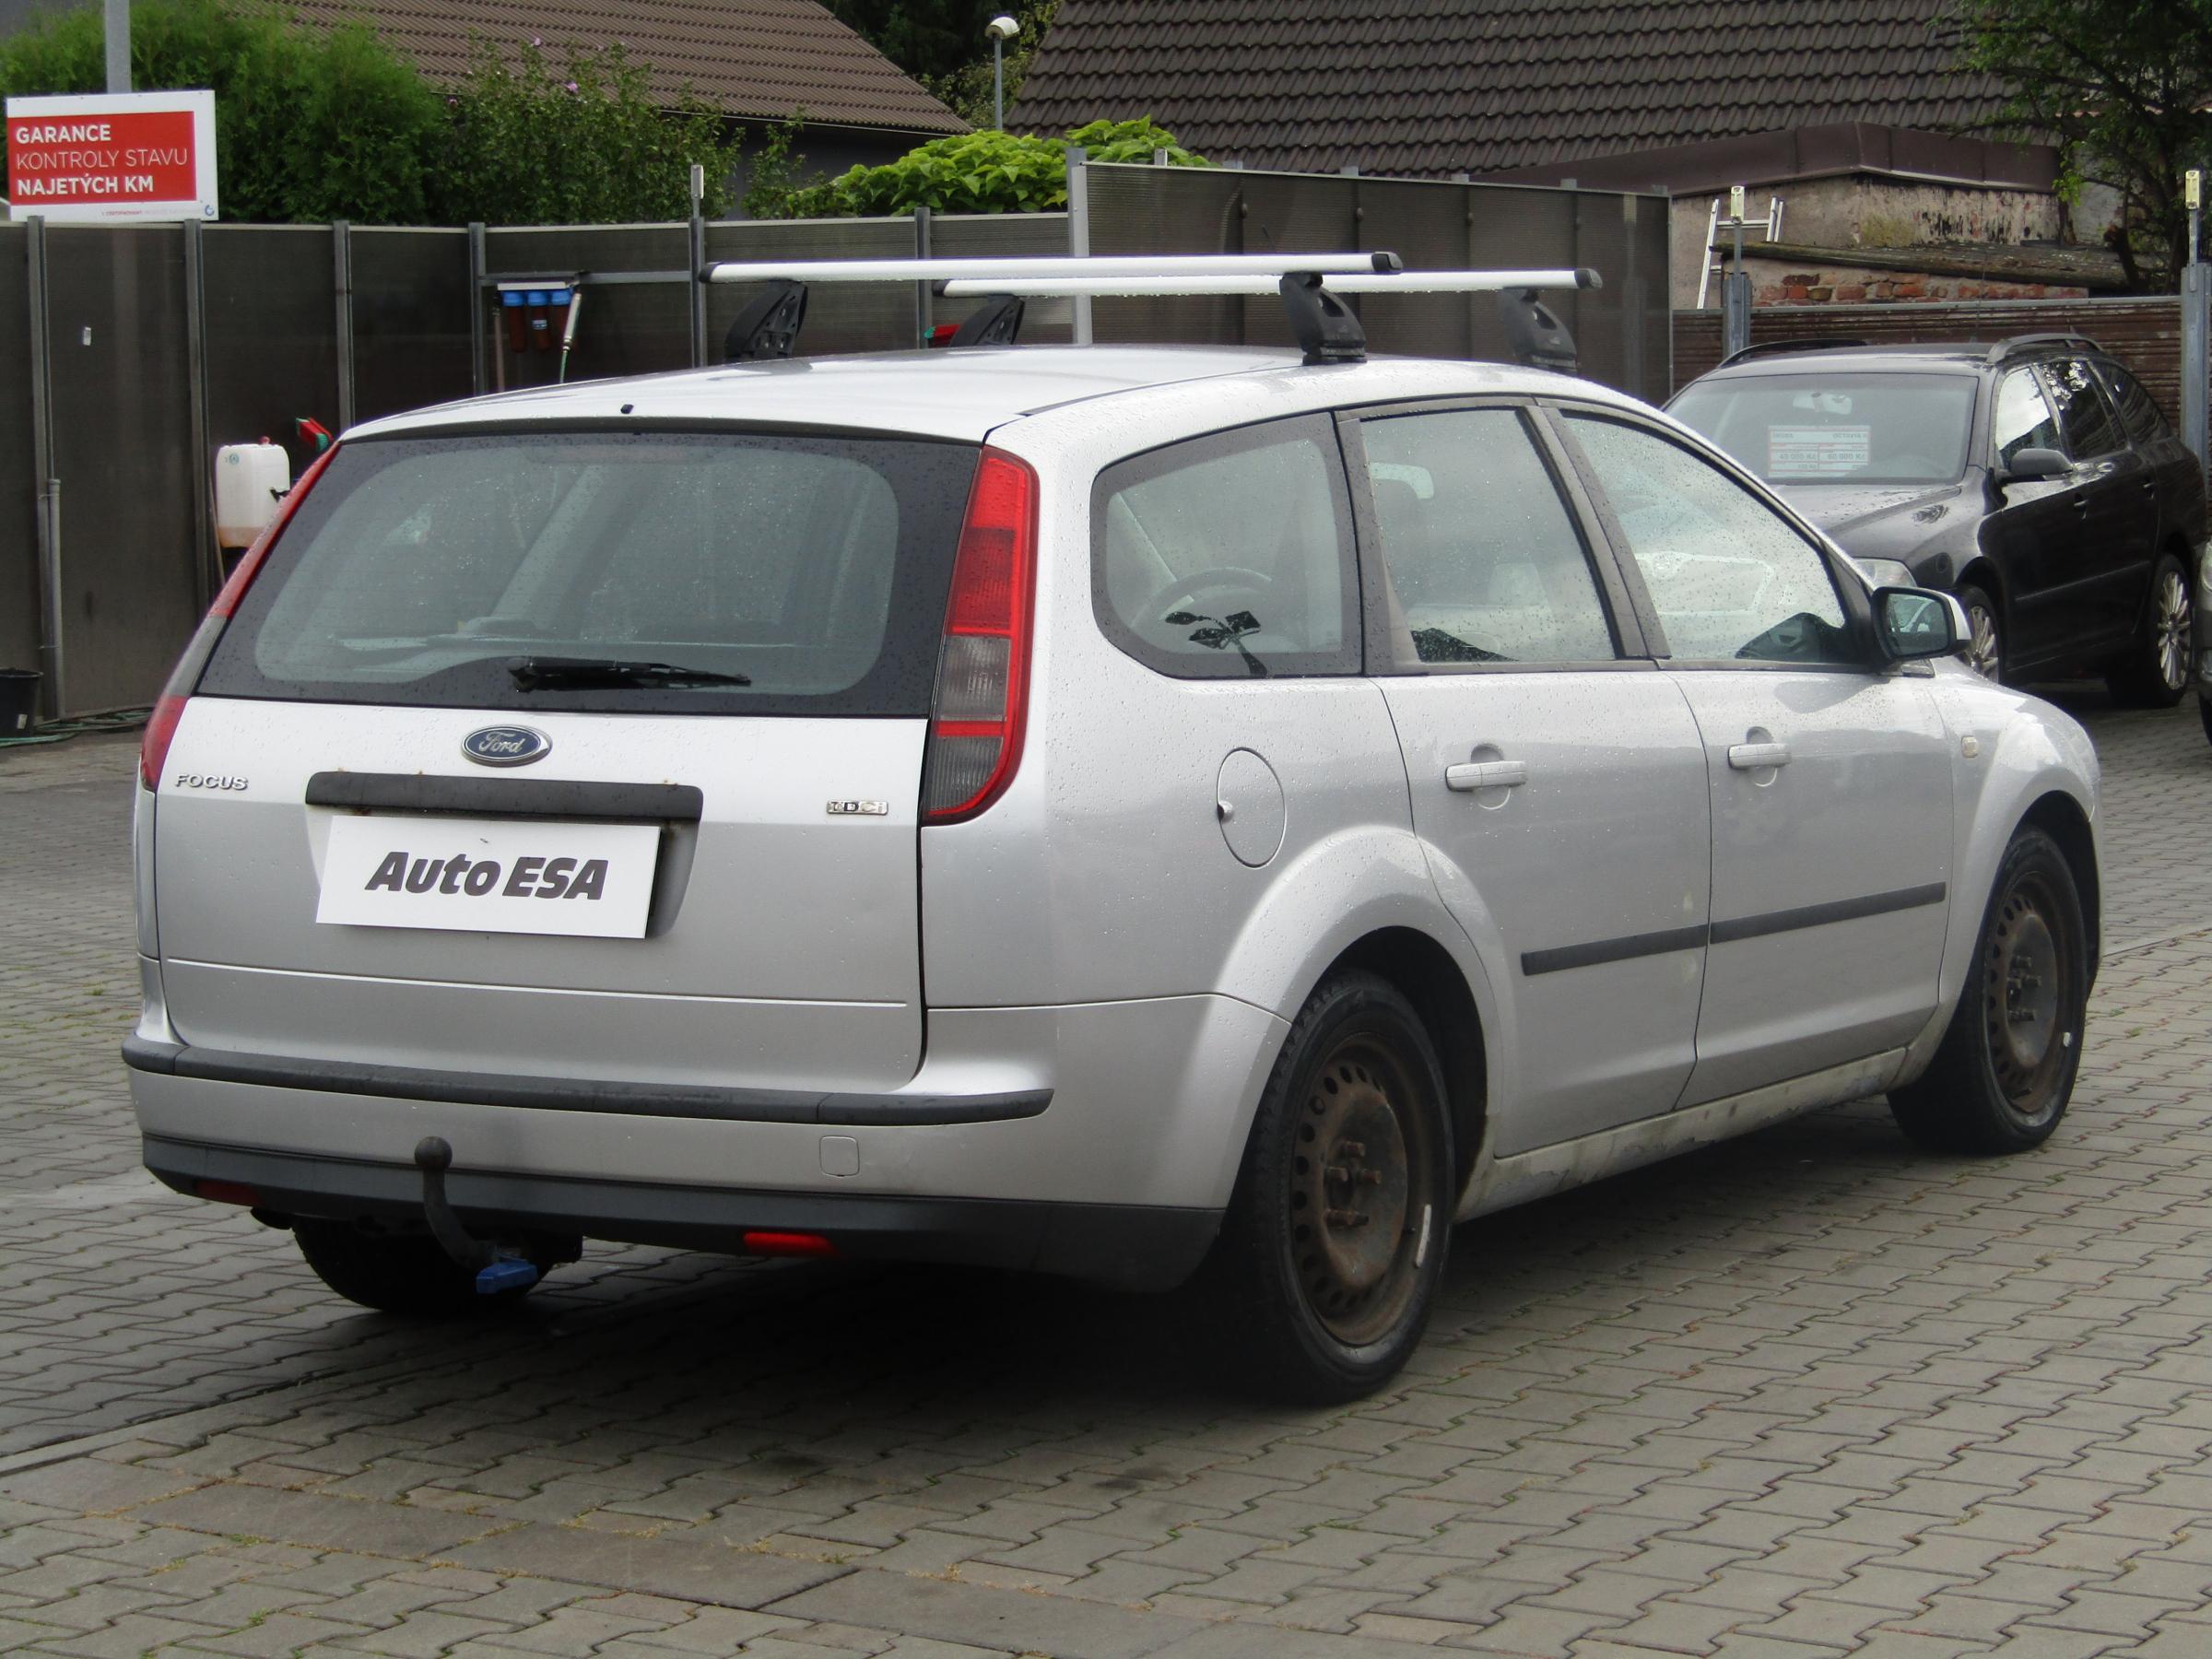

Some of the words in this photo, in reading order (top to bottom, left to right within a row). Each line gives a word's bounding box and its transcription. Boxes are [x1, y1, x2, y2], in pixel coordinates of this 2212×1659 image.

[16, 124, 112, 144] GARANCE
[17, 151, 120, 170] KONTROLY
[125, 147, 188, 167] STAVU
[18, 172, 119, 195] NAJETÝCH
[124, 175, 154, 193] KM
[478, 731, 526, 753] Ford
[175, 774, 249, 791] FOCUS
[364, 852, 501, 897] Auto
[502, 857, 609, 900] ESA
